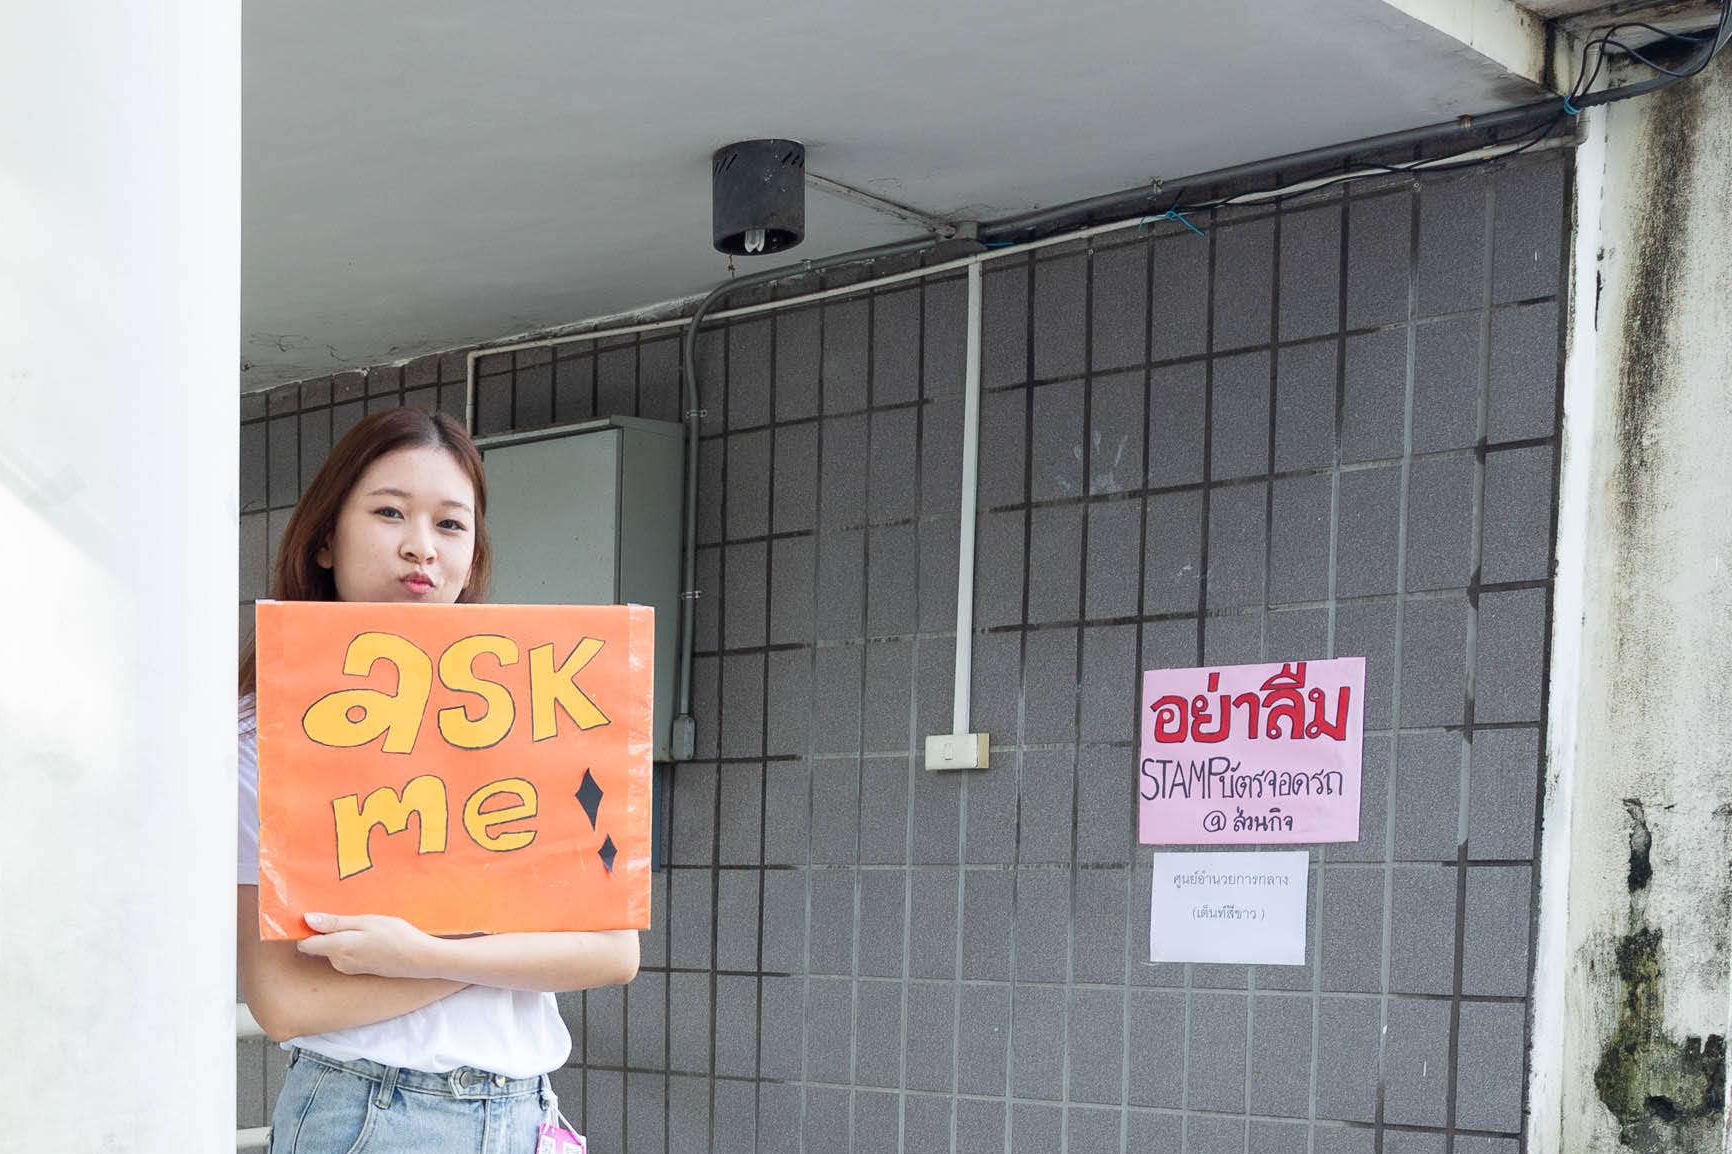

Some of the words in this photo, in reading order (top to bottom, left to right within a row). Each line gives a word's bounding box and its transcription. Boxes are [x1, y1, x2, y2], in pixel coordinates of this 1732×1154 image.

[1150, 662, 1351, 743] อย่าลืม
[331, 774, 538, 880] me
[1173, 870, 1289, 888] ศูนย์อำนวยการกลาง
